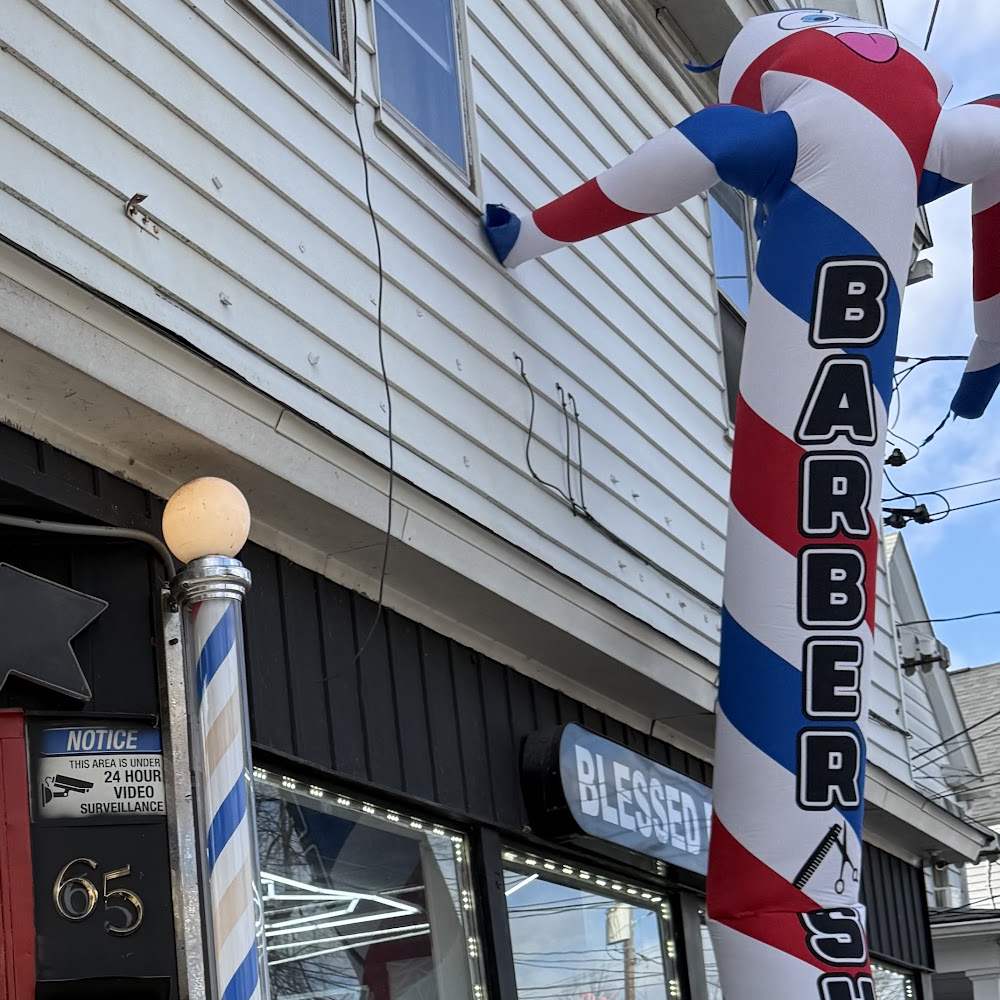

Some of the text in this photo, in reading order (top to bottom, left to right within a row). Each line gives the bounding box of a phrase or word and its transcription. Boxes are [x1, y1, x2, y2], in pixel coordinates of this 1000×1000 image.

[794, 256, 891, 811] BARBER
[66, 729, 139, 752] NOTICE
[69, 758, 161, 769] THIS AREA IS UNDER
[104, 769, 162, 783] 24 HOUR
[113, 785, 155, 799] VIDEO
[574, 743, 701, 856] BLESSED
[80, 801, 164, 814] SURVEILLANCE
[53, 857, 144, 937] 65
